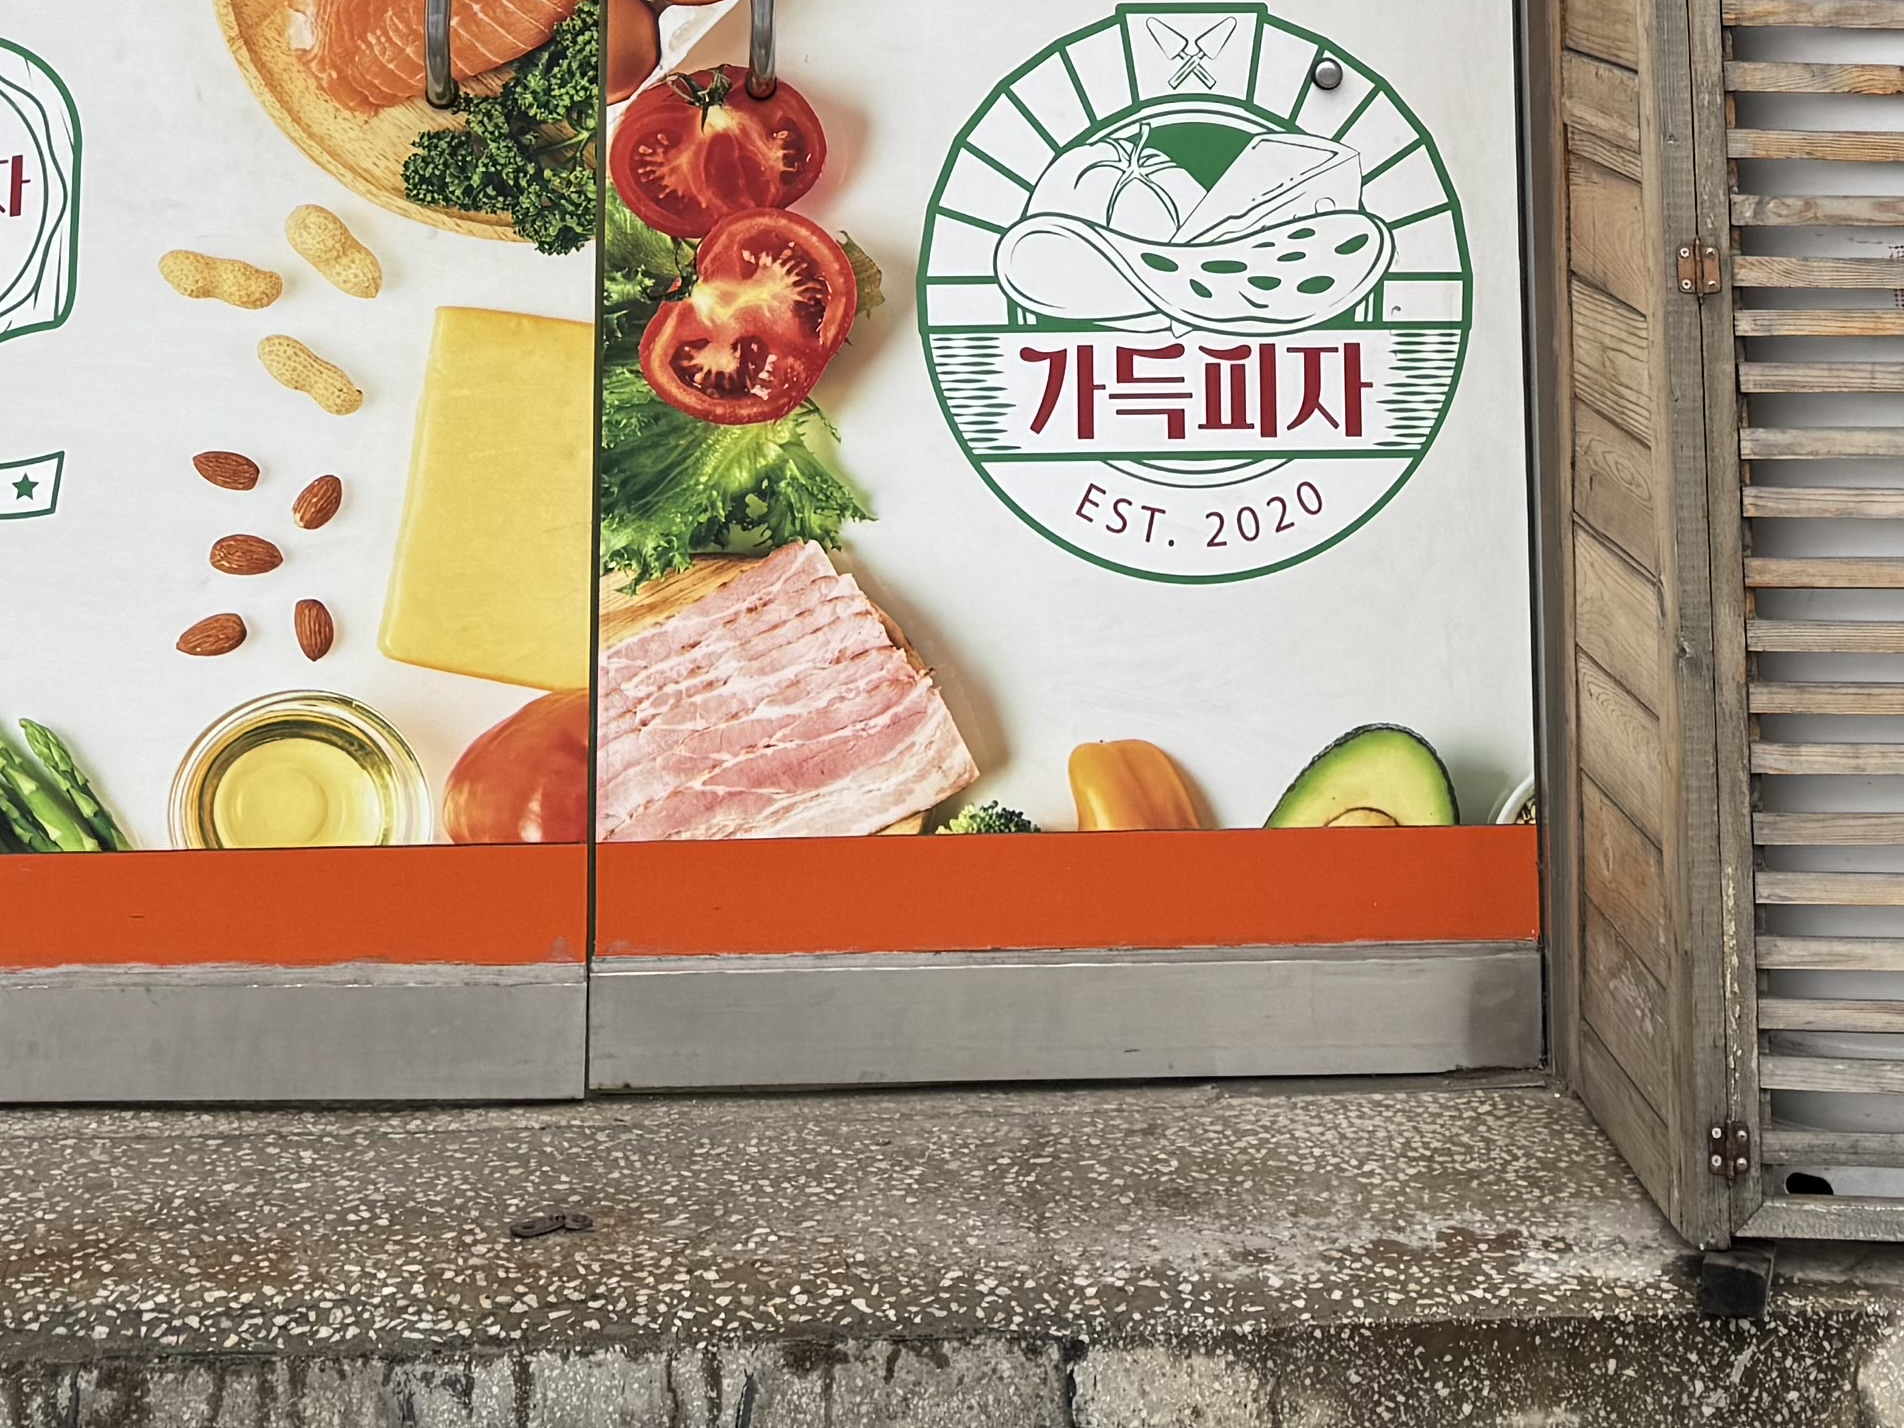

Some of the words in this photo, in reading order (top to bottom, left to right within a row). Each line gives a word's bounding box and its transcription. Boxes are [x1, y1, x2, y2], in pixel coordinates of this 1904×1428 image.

[1019, 341, 1374, 440] 가득피자
[1074, 482, 1176, 548] EST.
[1205, 480, 1324, 548] 2020
